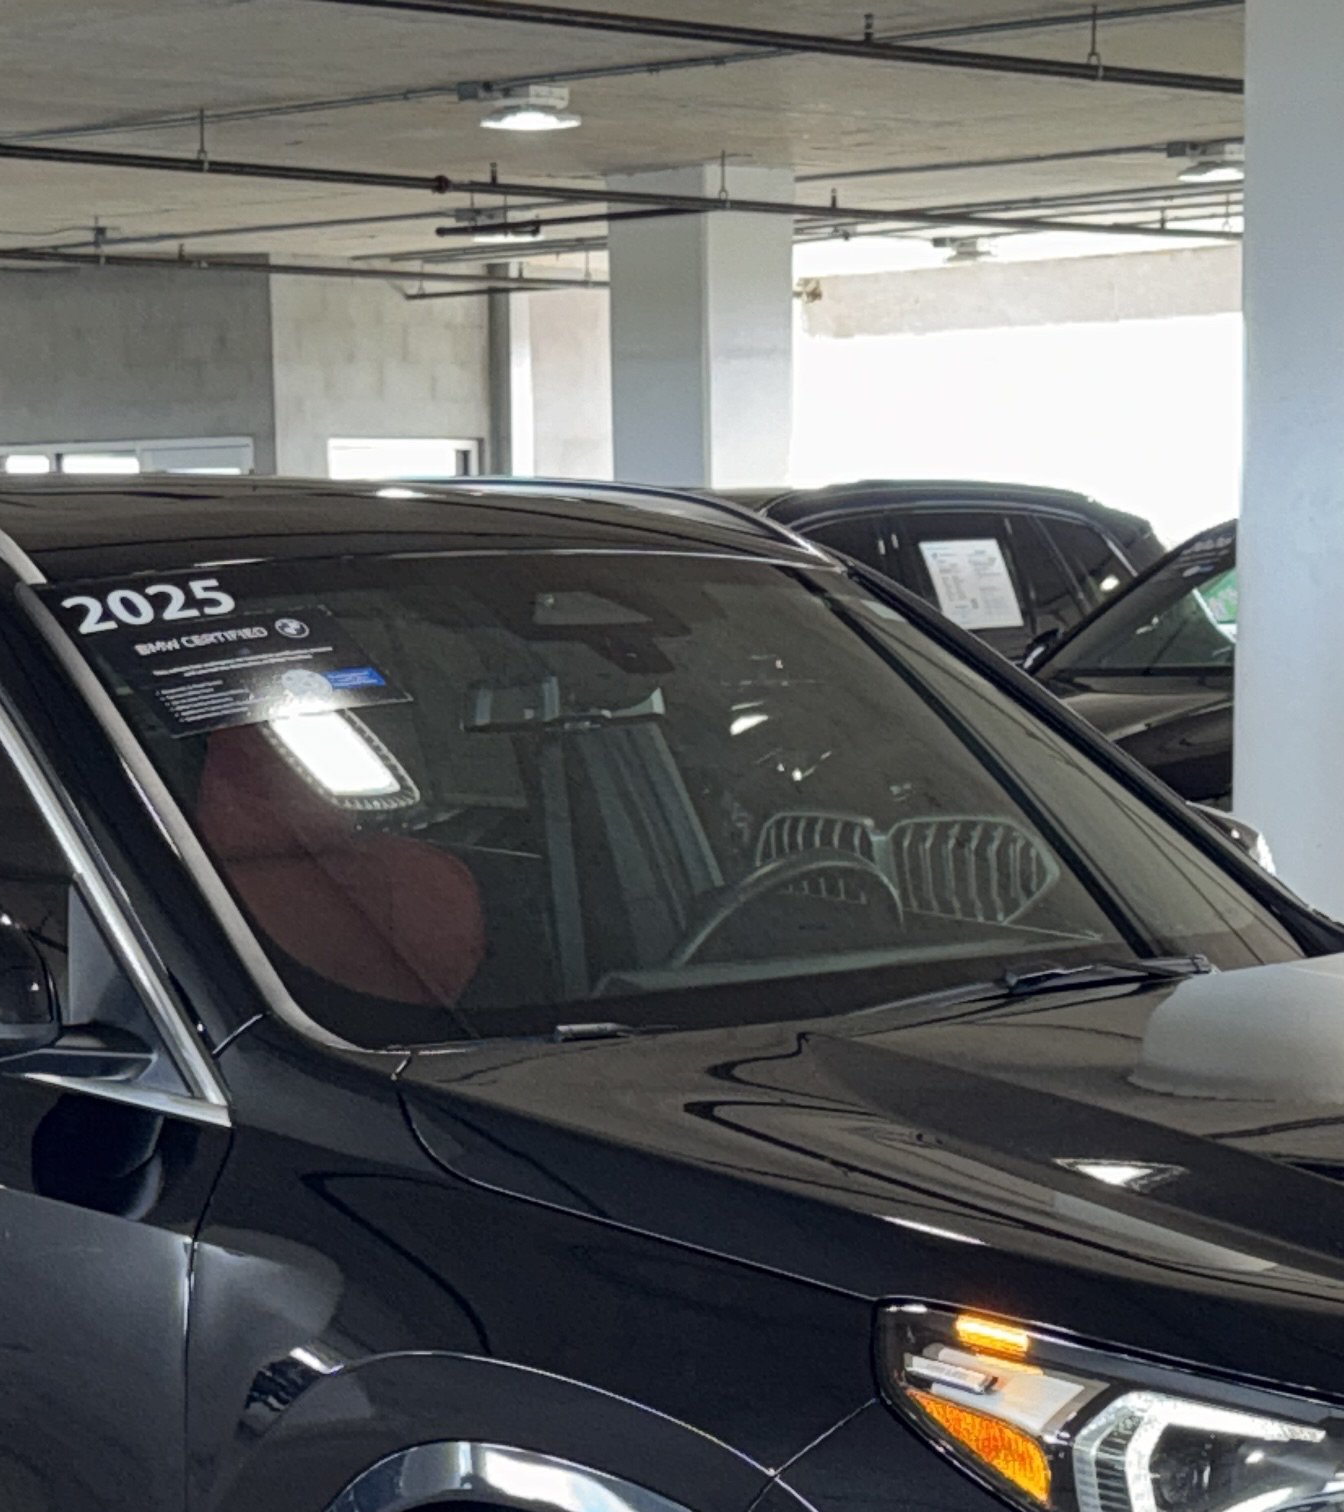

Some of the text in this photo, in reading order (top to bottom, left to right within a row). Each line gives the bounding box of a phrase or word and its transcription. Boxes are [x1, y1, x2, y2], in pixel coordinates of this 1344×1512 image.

[61, 578, 235, 634] 2025
[134, 626, 268, 656] BMW CERTIFIED
